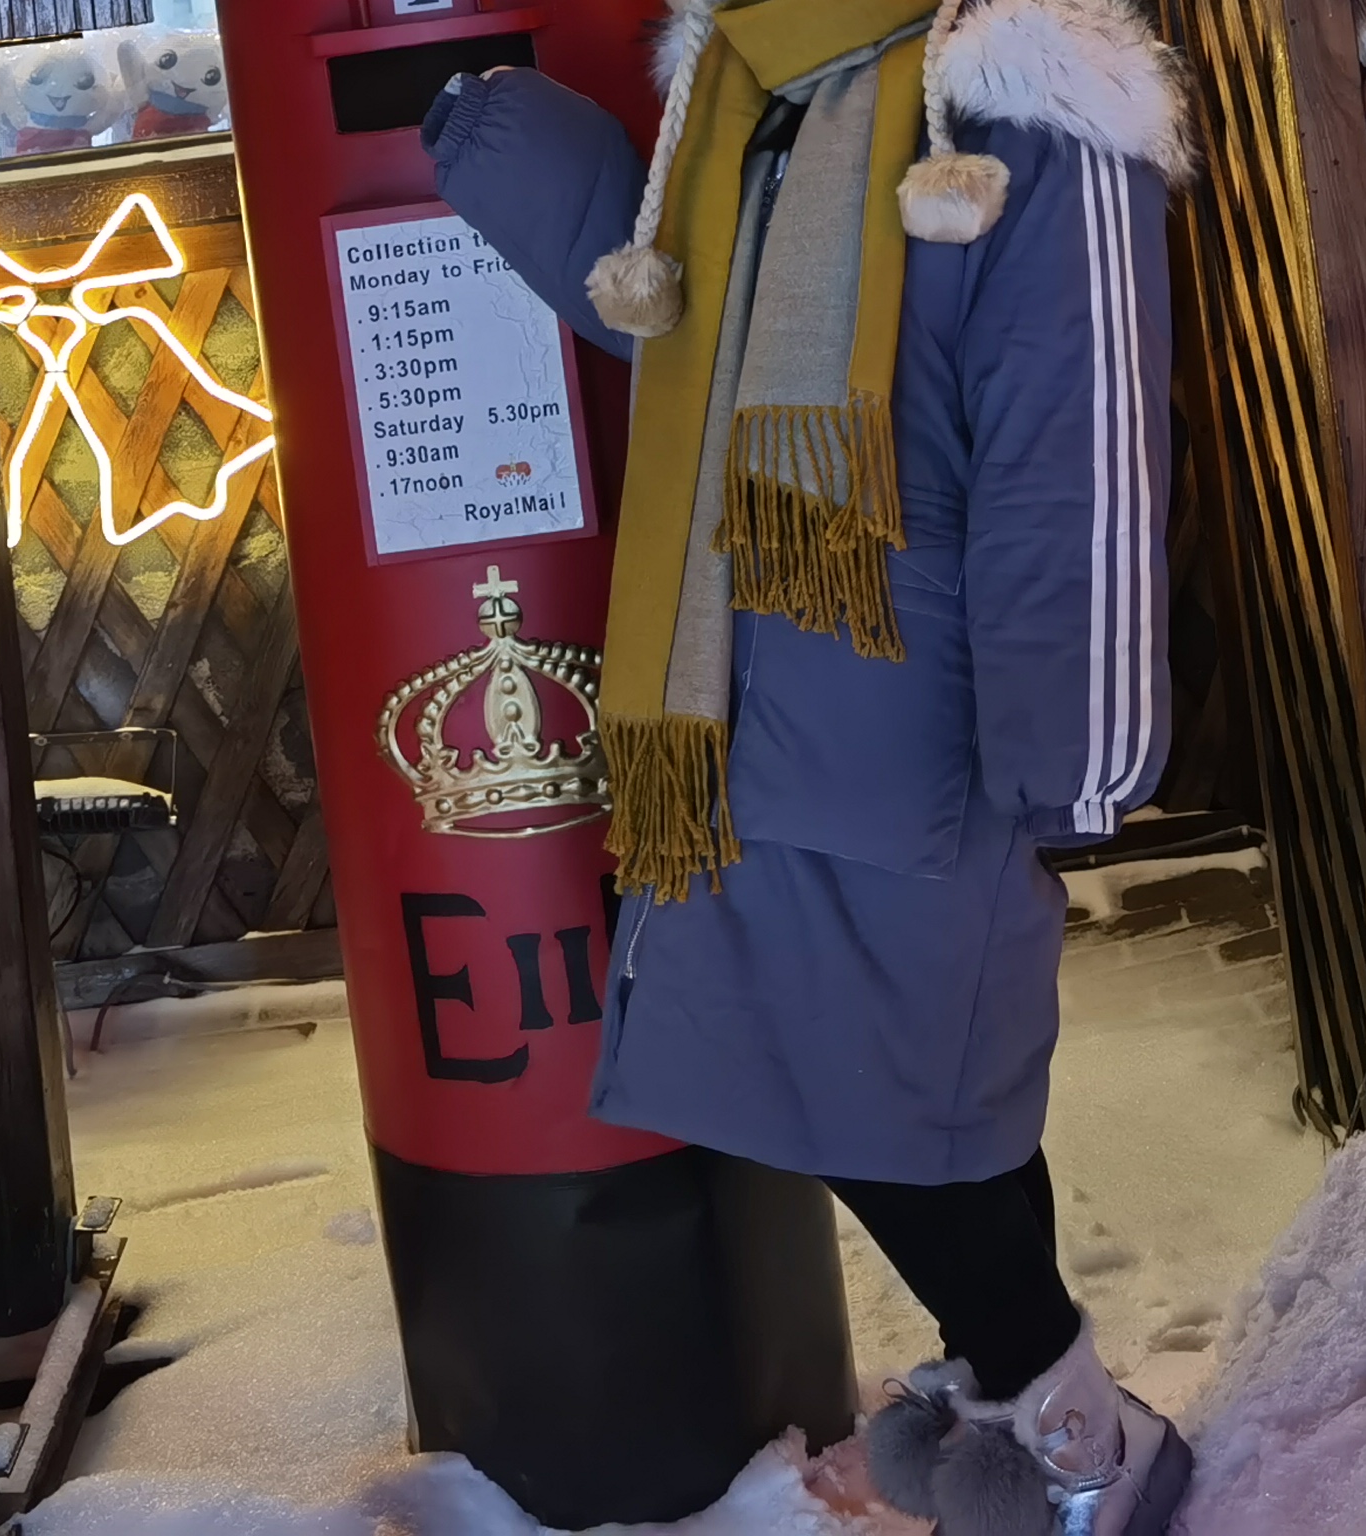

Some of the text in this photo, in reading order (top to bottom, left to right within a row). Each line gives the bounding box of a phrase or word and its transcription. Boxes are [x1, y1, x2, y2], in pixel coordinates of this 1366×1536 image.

[347, 234, 461, 264] Collection
[350, 267, 430, 292] Monday
[442, 263, 462, 279] to
[373, 401, 560, 439] Saturday 5.30pm
